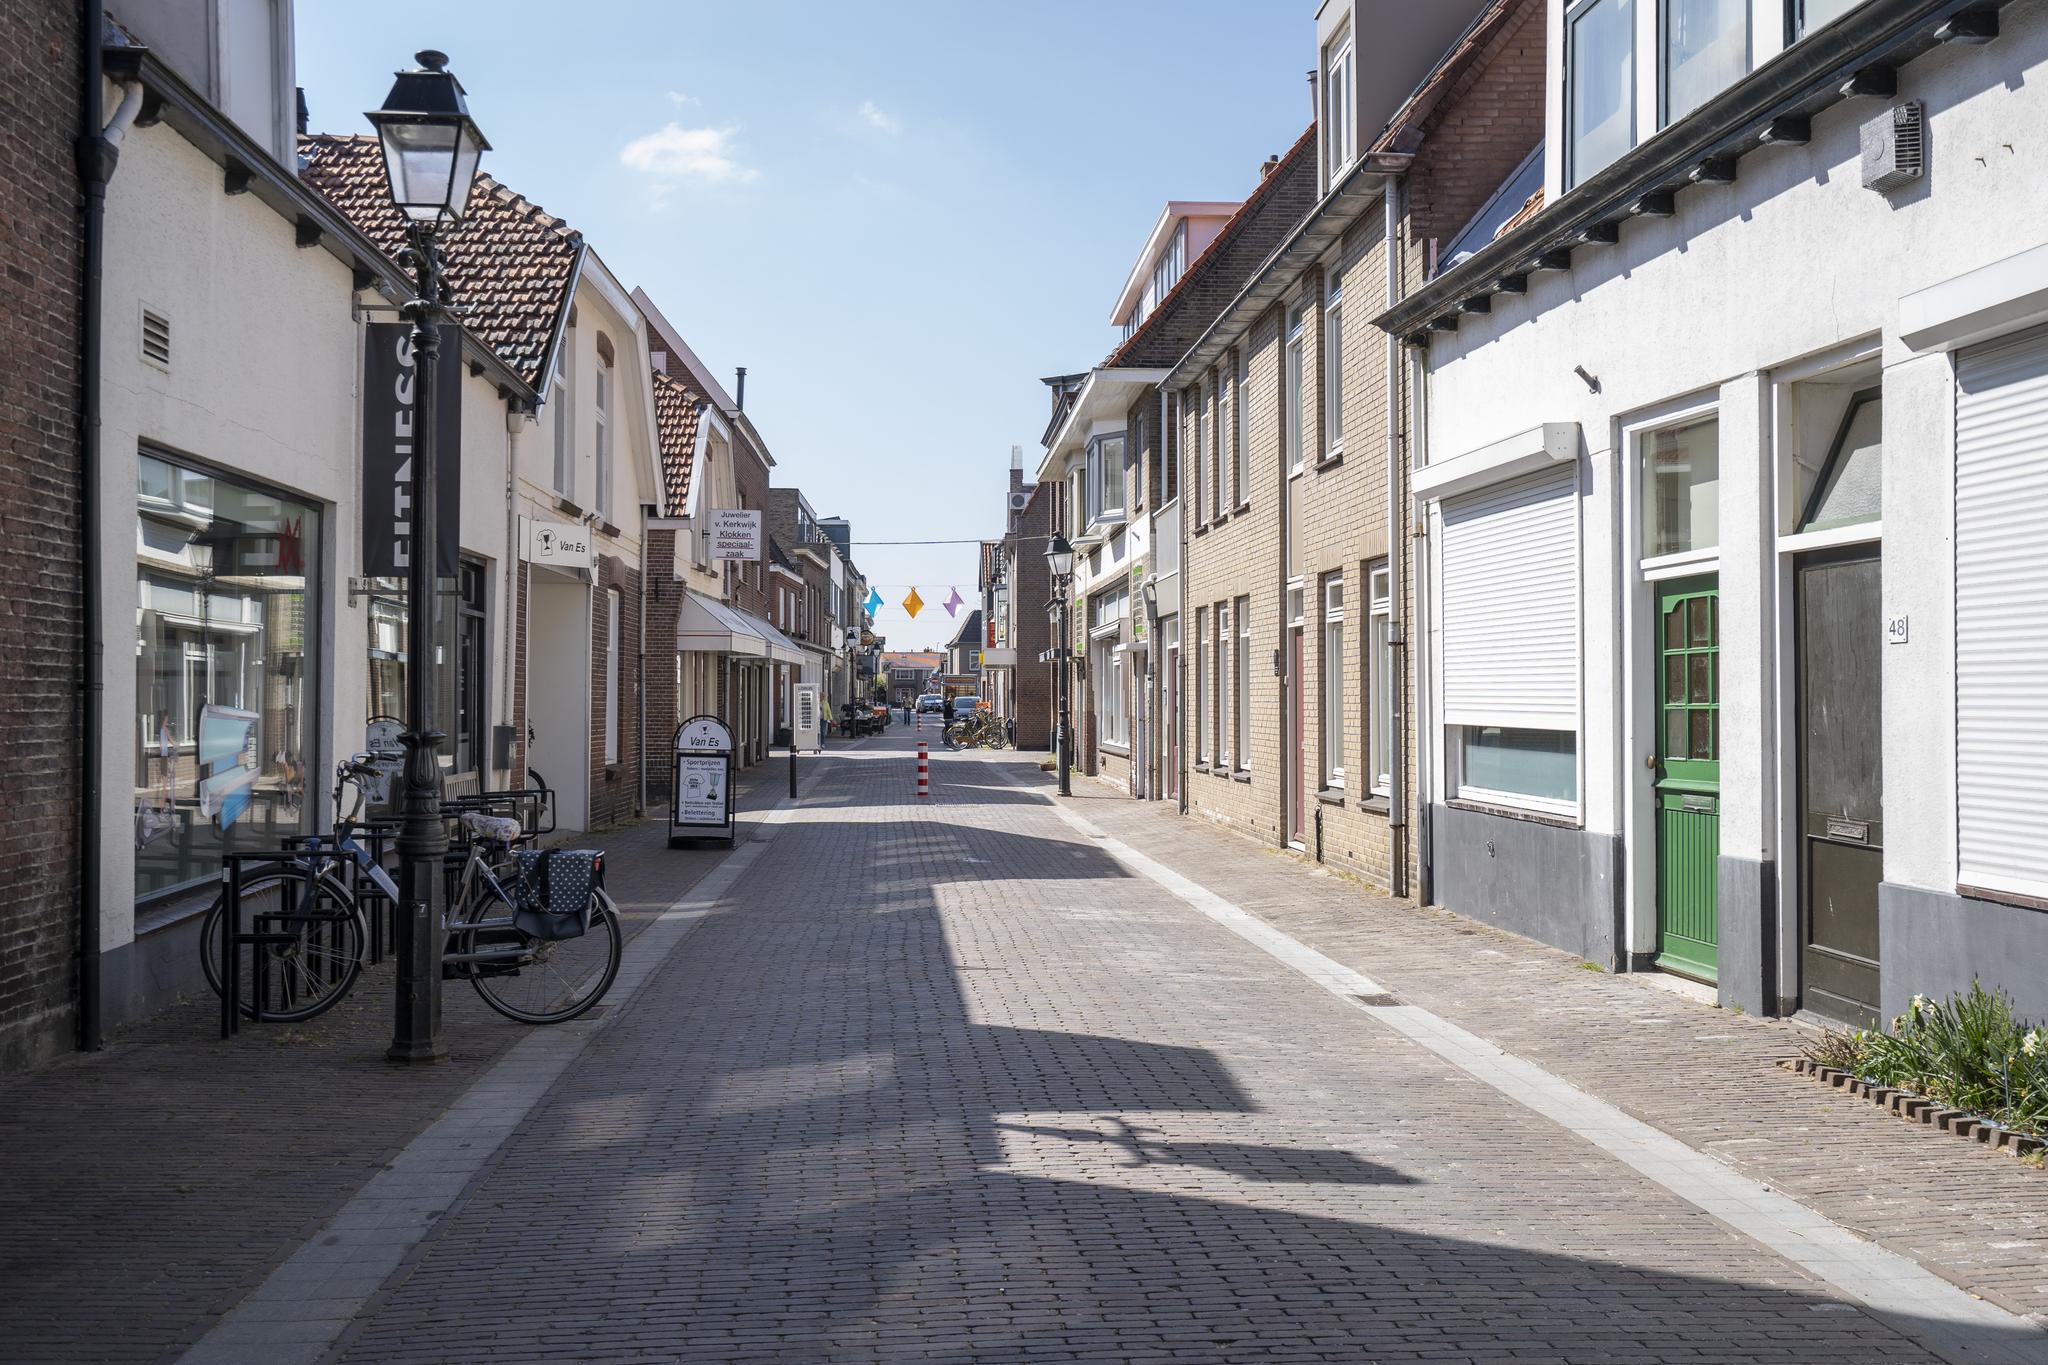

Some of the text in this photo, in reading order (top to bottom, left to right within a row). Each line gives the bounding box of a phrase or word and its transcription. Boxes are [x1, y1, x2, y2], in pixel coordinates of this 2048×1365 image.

[723, 520, 757, 529] Kerkwijk
[560, 541, 586, 552] Van Es
[1889, 619, 1905, 636] 48
[690, 737, 719, 747] Van Es
